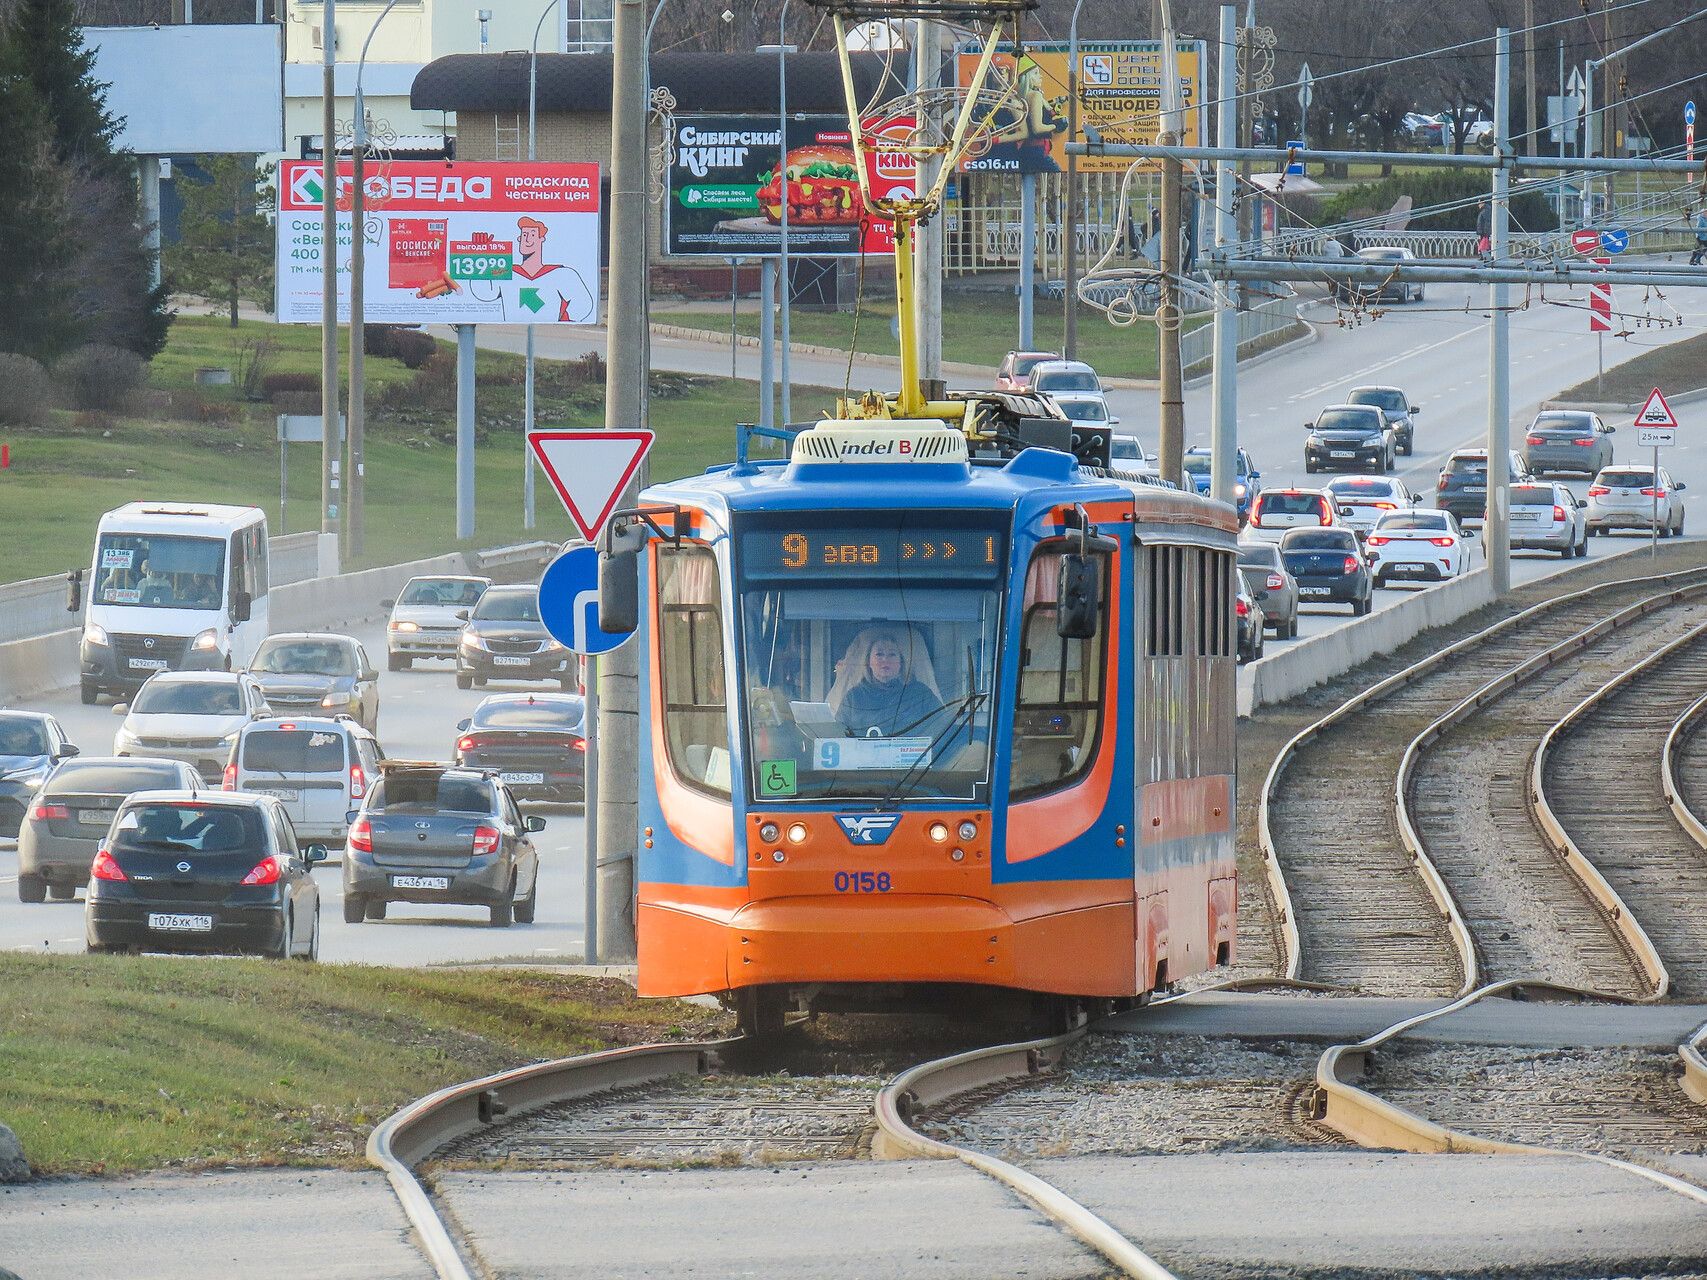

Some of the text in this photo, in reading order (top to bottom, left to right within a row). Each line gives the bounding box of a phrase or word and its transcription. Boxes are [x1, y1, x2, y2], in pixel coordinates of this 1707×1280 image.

[963, 158, 1020, 170] cso16.ru
[505, 177, 590, 189] продсклад
[505, 191, 590, 202] честных цен
[395, 240, 440, 250] СОСИСКИ
[456, 243, 488, 251] выгода
[291, 248, 320, 260] 400
[840, 440, 912, 455] indel B
[782, 532, 809, 568] 9
[984, 536, 995, 563] 1
[820, 741, 841, 769] 9
[834, 871, 891, 893] 0158
